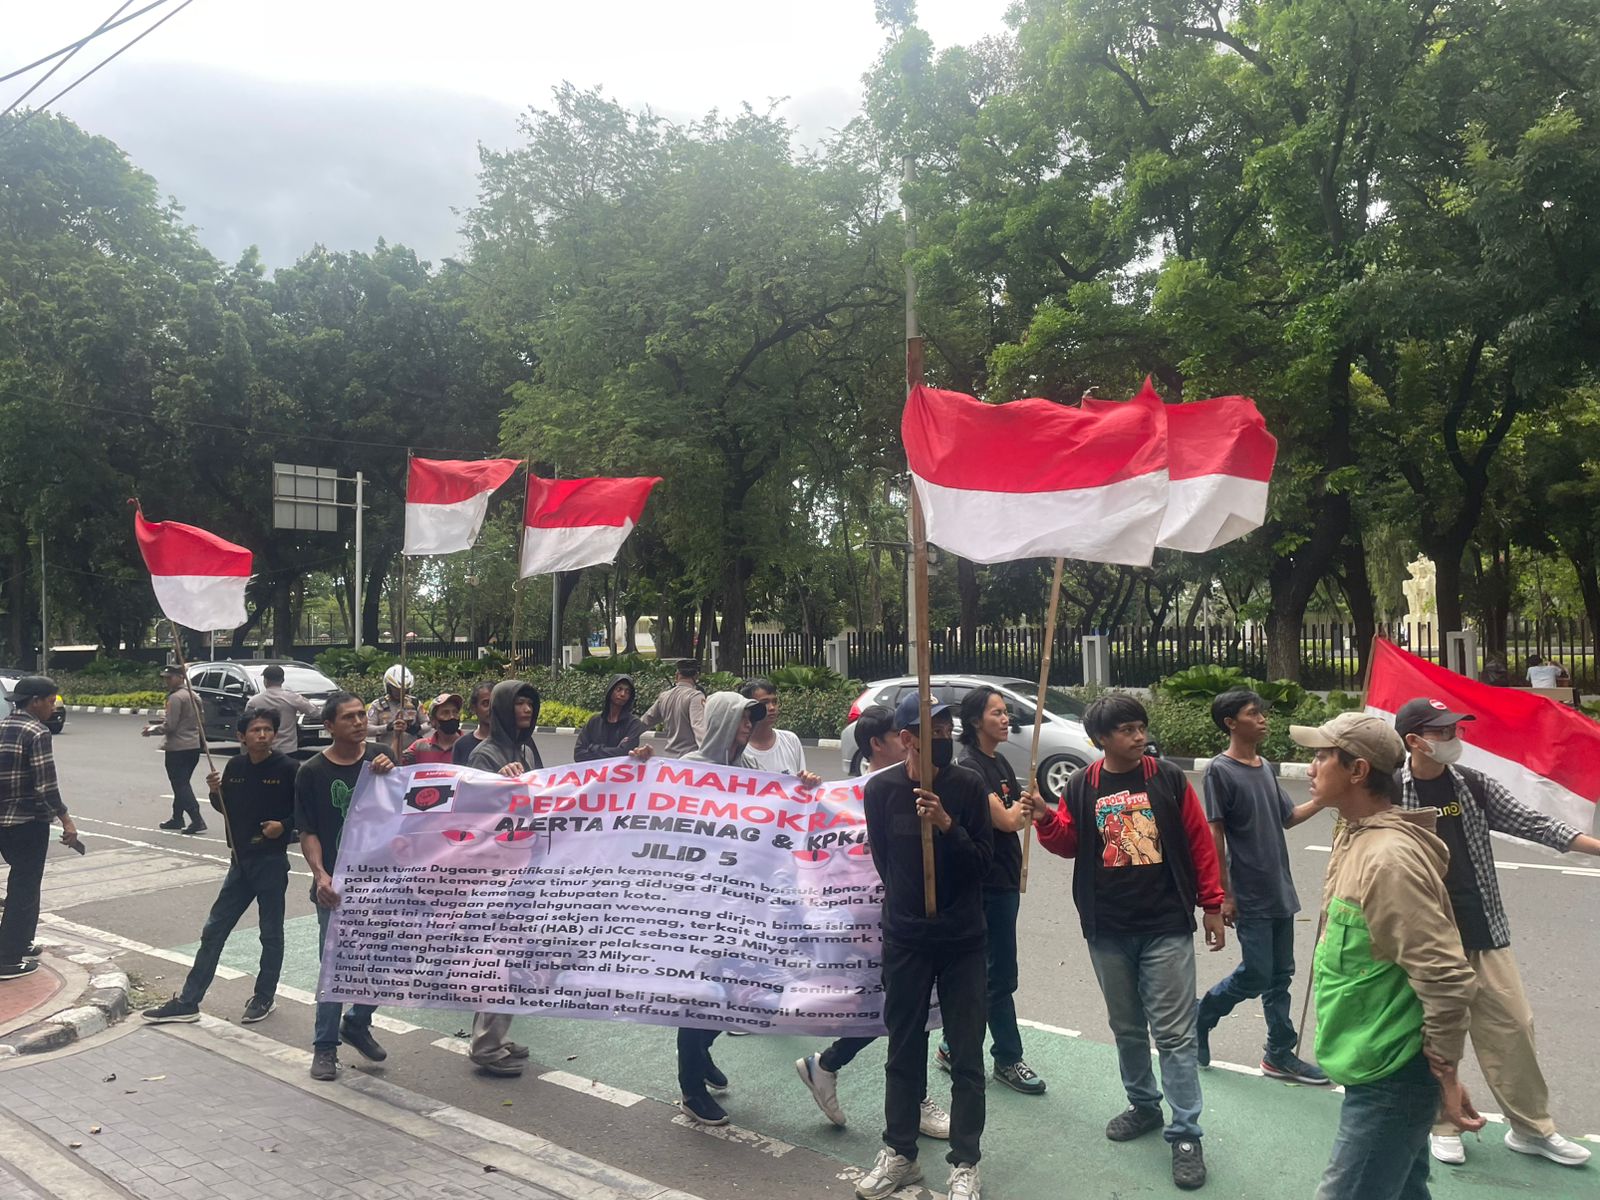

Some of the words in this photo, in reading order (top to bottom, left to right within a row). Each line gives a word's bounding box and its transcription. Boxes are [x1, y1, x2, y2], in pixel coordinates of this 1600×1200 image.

[508, 793, 636, 814] PEDULI
[495, 816, 603, 832] ALERTA
[612, 815, 760, 842] KEMENAG
[772, 834, 794, 850] &
[632, 844, 706, 862] JILID
[718, 852, 738, 866] 5
[344, 876, 380, 886] pada
[383, 876, 436, 886] kegiatan
[440, 876, 506, 888] kemenag
[508, 878, 546, 887] jawa
[550, 878, 588, 886] timur
[592, 879, 631, 888] yang
[635, 879, 696, 892] diduga
[700, 885, 717, 894] di
[722, 886, 765, 904] kutip
[430, 865, 487, 876] Dugaan
[492, 866, 565, 876] gratifikasi
[569, 867, 614, 876] sekjen
[618, 866, 696, 881] kemenag
[700, 873, 755, 888] dalam
[345, 886, 369, 894] dan
[372, 886, 414, 894] seluruh
[418, 887, 467, 899] kepala
[471, 889, 536, 899] kemenag
[540, 889, 619, 900] kabupaten
[624, 890, 667, 900] kota.
[342, 908, 369, 917] yang
[401, 909, 418, 917] ini
[422, 910, 487, 921] menjabat
[490, 912, 548, 923] sebagai
[552, 912, 599, 923] sekjen
[604, 914, 685, 929] kemenag,
[690, 920, 754, 936] terkait
[755, 930, 820, 945] dugaan
[825, 934, 873, 944] mark
[345, 896, 355, 904] 2.
[358, 896, 383, 904] Usut
[386, 898, 426, 906] tuntas
[430, 899, 484, 910] dugaan
[487, 900, 612, 910] penyalahgunaan
[616, 903, 712, 919] wewenang
[716, 911, 767, 928] dirjen
[337, 940, 358, 948] JCC
[359, 942, 388, 951] yang
[392, 943, 494, 956] menghabiskan
[496, 949, 572, 958] anggaran
[578, 950, 597, 958] 23
[600, 951, 656, 962] Milyar.
[351, 930, 394, 940] Panggil
[397, 931, 422, 940] dan
[426, 932, 480, 943] periksa
[484, 934, 523, 944] Event
[526, 937, 596, 948] orginizer
[600, 939, 684, 952] pelaksana
[690, 945, 769, 964] kegiatan
[816, 960, 862, 969] amal
[368, 918, 422, 929] kegiatan
[426, 921, 456, 930] Hari
[459, 922, 496, 931] amal
[500, 923, 538, 932] bakti
[541, 924, 584, 936] (HAB)
[588, 926, 602, 935] di
[606, 926, 636, 935] JCC
[640, 929, 708, 942] sebesar
[714, 934, 736, 945] 23
[742, 939, 804, 956] Milyar.
[335, 963, 364, 972] ismail
[368, 964, 390, 974] dan
[394, 968, 444, 977] wawan
[446, 970, 502, 980] junaidi.
[337, 952, 346, 960] 4.
[374, 954, 412, 963] tuntas
[416, 956, 470, 968] Dugaan
[472, 958, 500, 968] jual
[504, 958, 531, 969] beli
[534, 960, 595, 972] jabatan
[598, 963, 611, 972] di
[616, 964, 650, 975] biro
[654, 967, 695, 980] SDM
[700, 972, 785, 993] kemenag
[332, 986, 371, 996] daerah
[373, 989, 404, 1000] yang
[408, 991, 482, 1003] terindikasi
[486, 996, 516, 1005] ada
[520, 998, 610, 1012] keterlibatan
[614, 1004, 680, 1018] staffsus
[685, 1008, 776, 1027] kemenag.
[334, 974, 342, 983] 5.
[345, 975, 368, 984] Usut
[372, 978, 410, 987] tuntas
[414, 979, 468, 991] Dugaan
[471, 982, 550, 994] gratifikasi
[554, 987, 582, 997] dan
[584, 988, 612, 999] jual
[616, 990, 645, 1001] beli
[650, 992, 721, 1008] jabatan
[795, 1008, 880, 1020] kemenag
